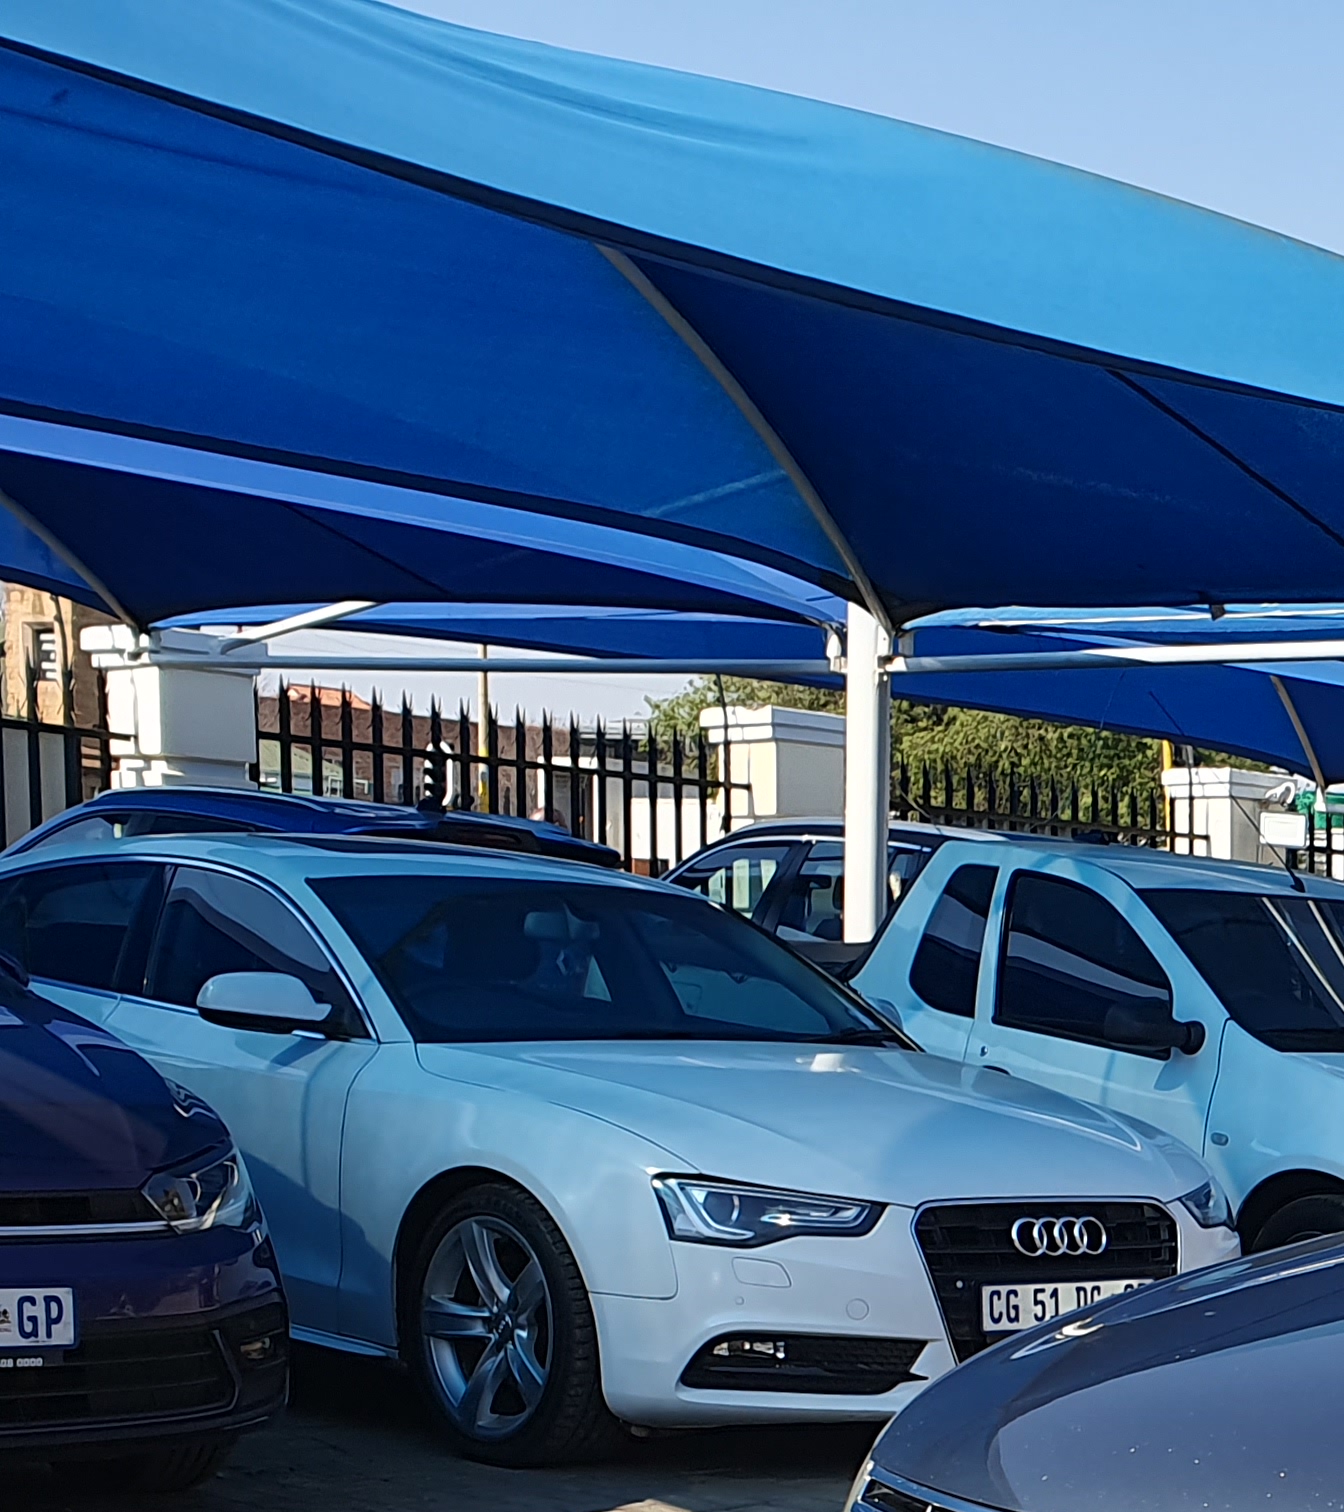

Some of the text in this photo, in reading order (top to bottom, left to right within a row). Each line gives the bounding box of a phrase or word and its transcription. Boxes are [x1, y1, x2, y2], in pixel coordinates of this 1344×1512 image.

[17, 1294, 64, 1339] GP
[989, 1289, 1020, 1324] CG
[1033, 1287, 1060, 1322] 51
